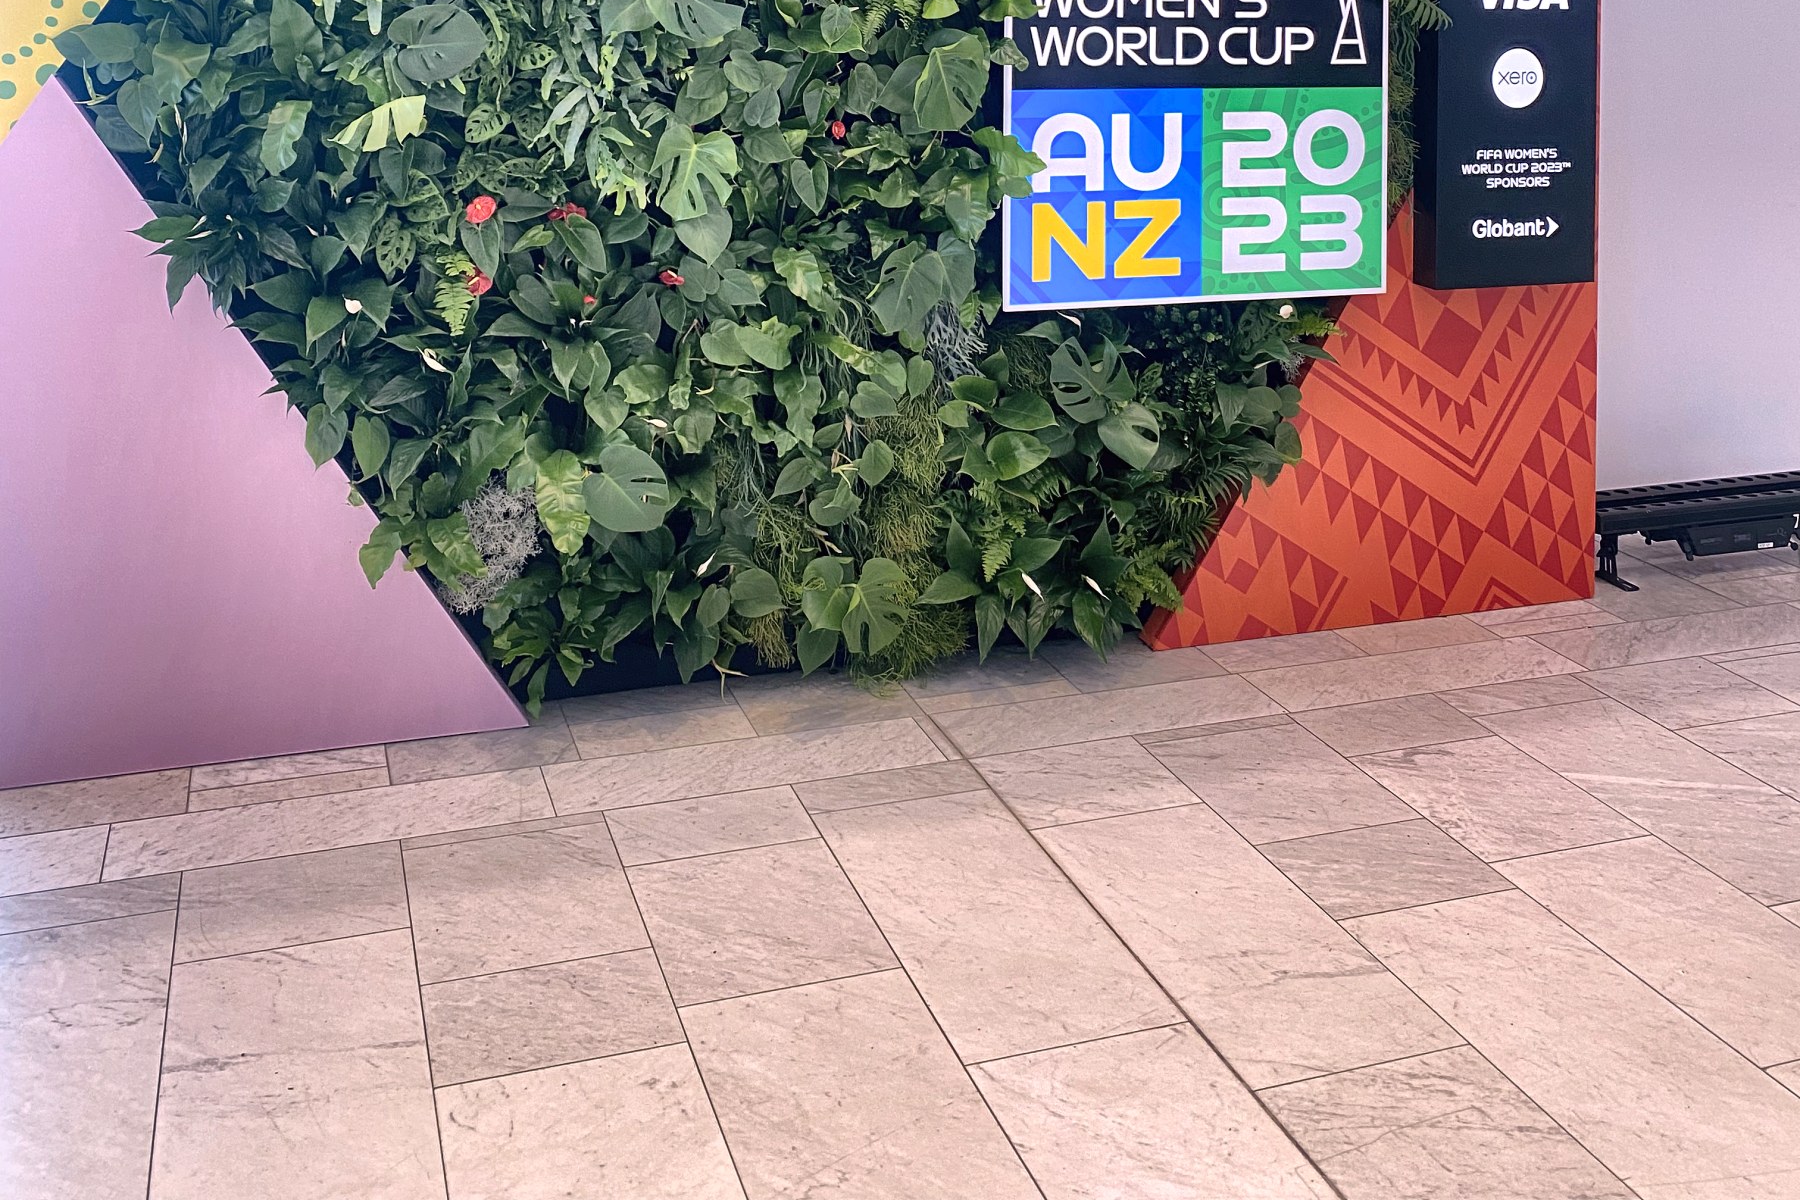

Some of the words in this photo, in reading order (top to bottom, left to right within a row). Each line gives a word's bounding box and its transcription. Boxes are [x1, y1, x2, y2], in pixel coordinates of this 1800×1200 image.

[1029, 25, 1210, 67] WORLD
[1217, 26, 1315, 66] CUP
[1498, 70, 1538, 85] xero
[1031, 111, 1183, 193] AU
[1222, 108, 1366, 188] 20
[1476, 149, 1503, 160] FIFA
[1504, 147, 1558, 160] WOMEN'S
[1461, 162, 1503, 175] WORLD
[1504, 162, 1529, 174] CUP
[1486, 176, 1551, 189] SPONSORS
[1031, 198, 1182, 282] NZ
[1221, 194, 1363, 274] 23
[1471, 218, 1546, 239] Globant
